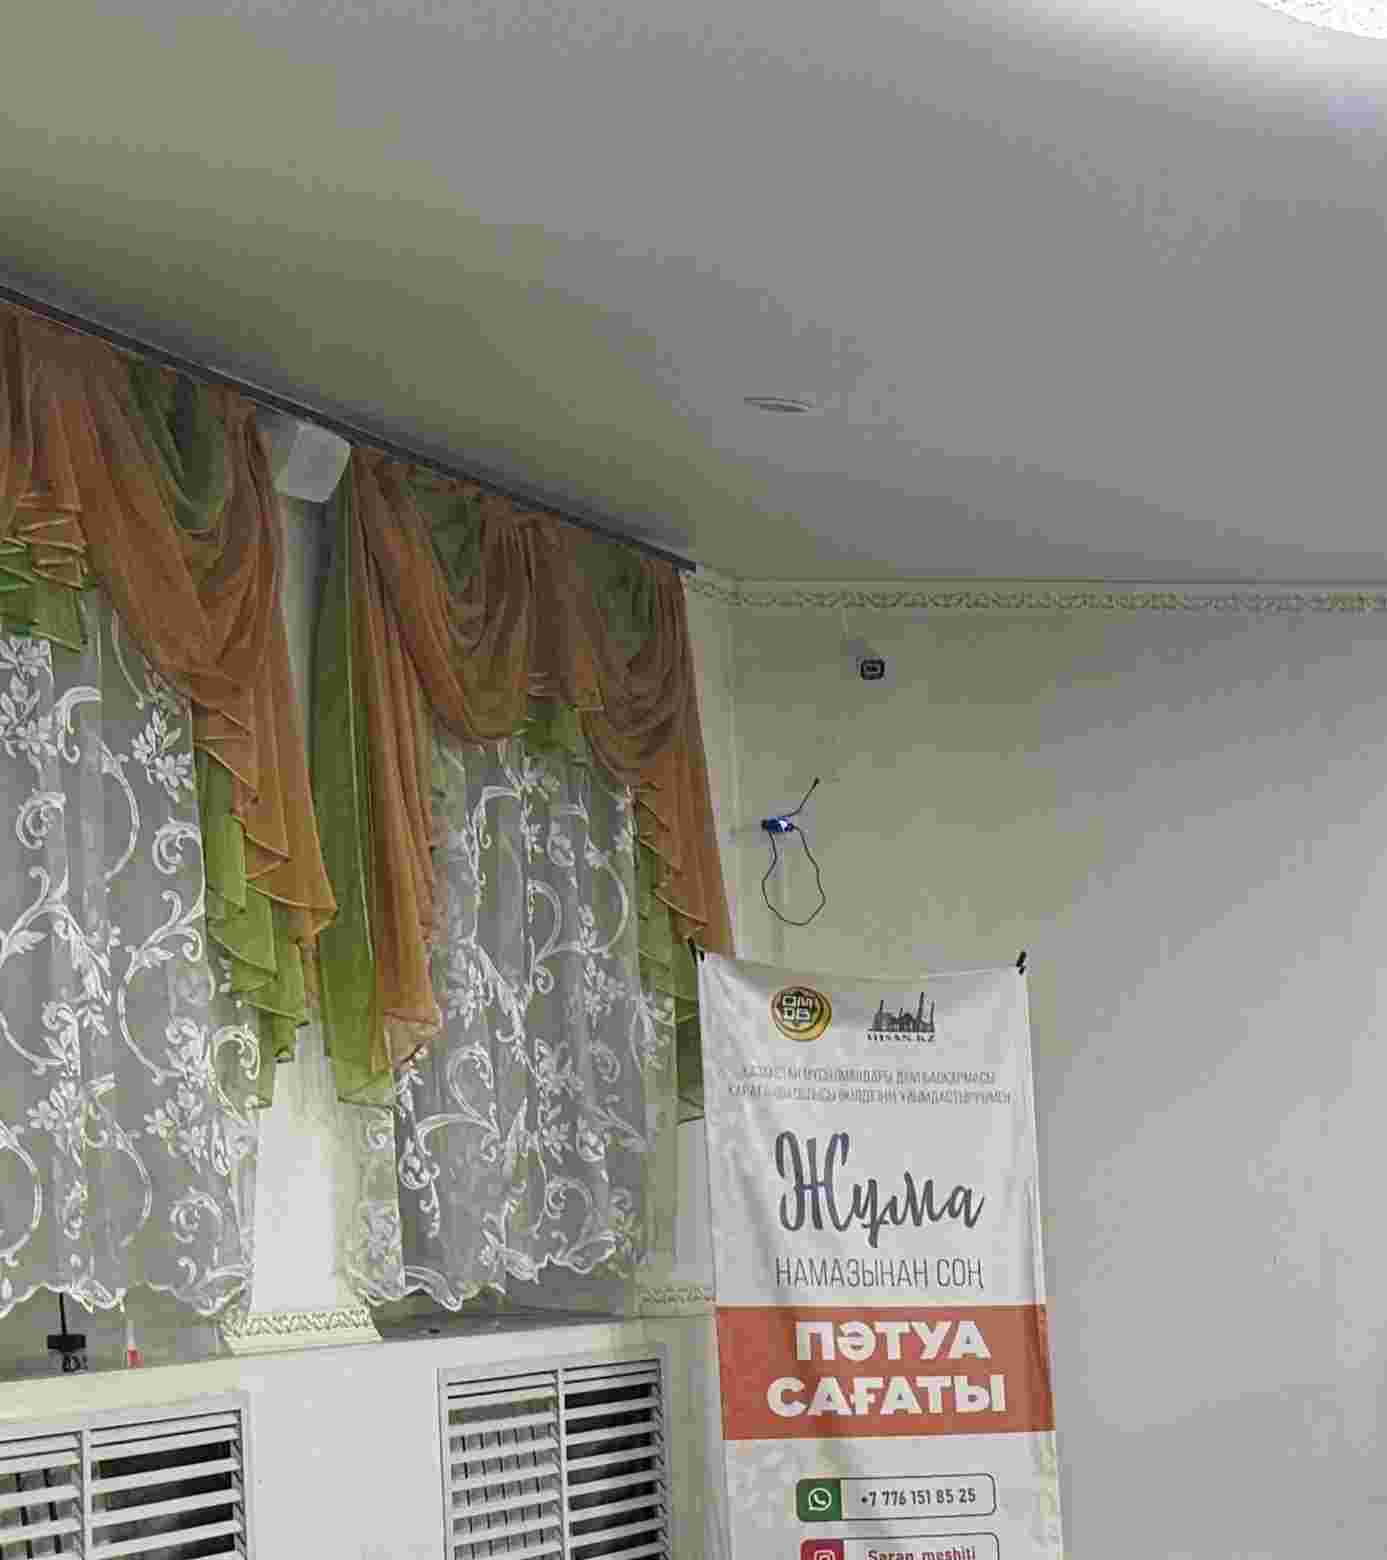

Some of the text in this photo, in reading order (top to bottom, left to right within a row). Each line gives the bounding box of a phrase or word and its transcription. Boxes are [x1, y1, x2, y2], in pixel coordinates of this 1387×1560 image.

[775, 1130, 985, 1248] Жума
[775, 1256, 985, 1289] НАМАЗЫНАН СОҢ
[795, 1320, 992, 1362] ПӘТУА
[767, 1374, 1008, 1417] САҒАТЫ
[861, 1487, 977, 1507] +7 776 151 85 25
